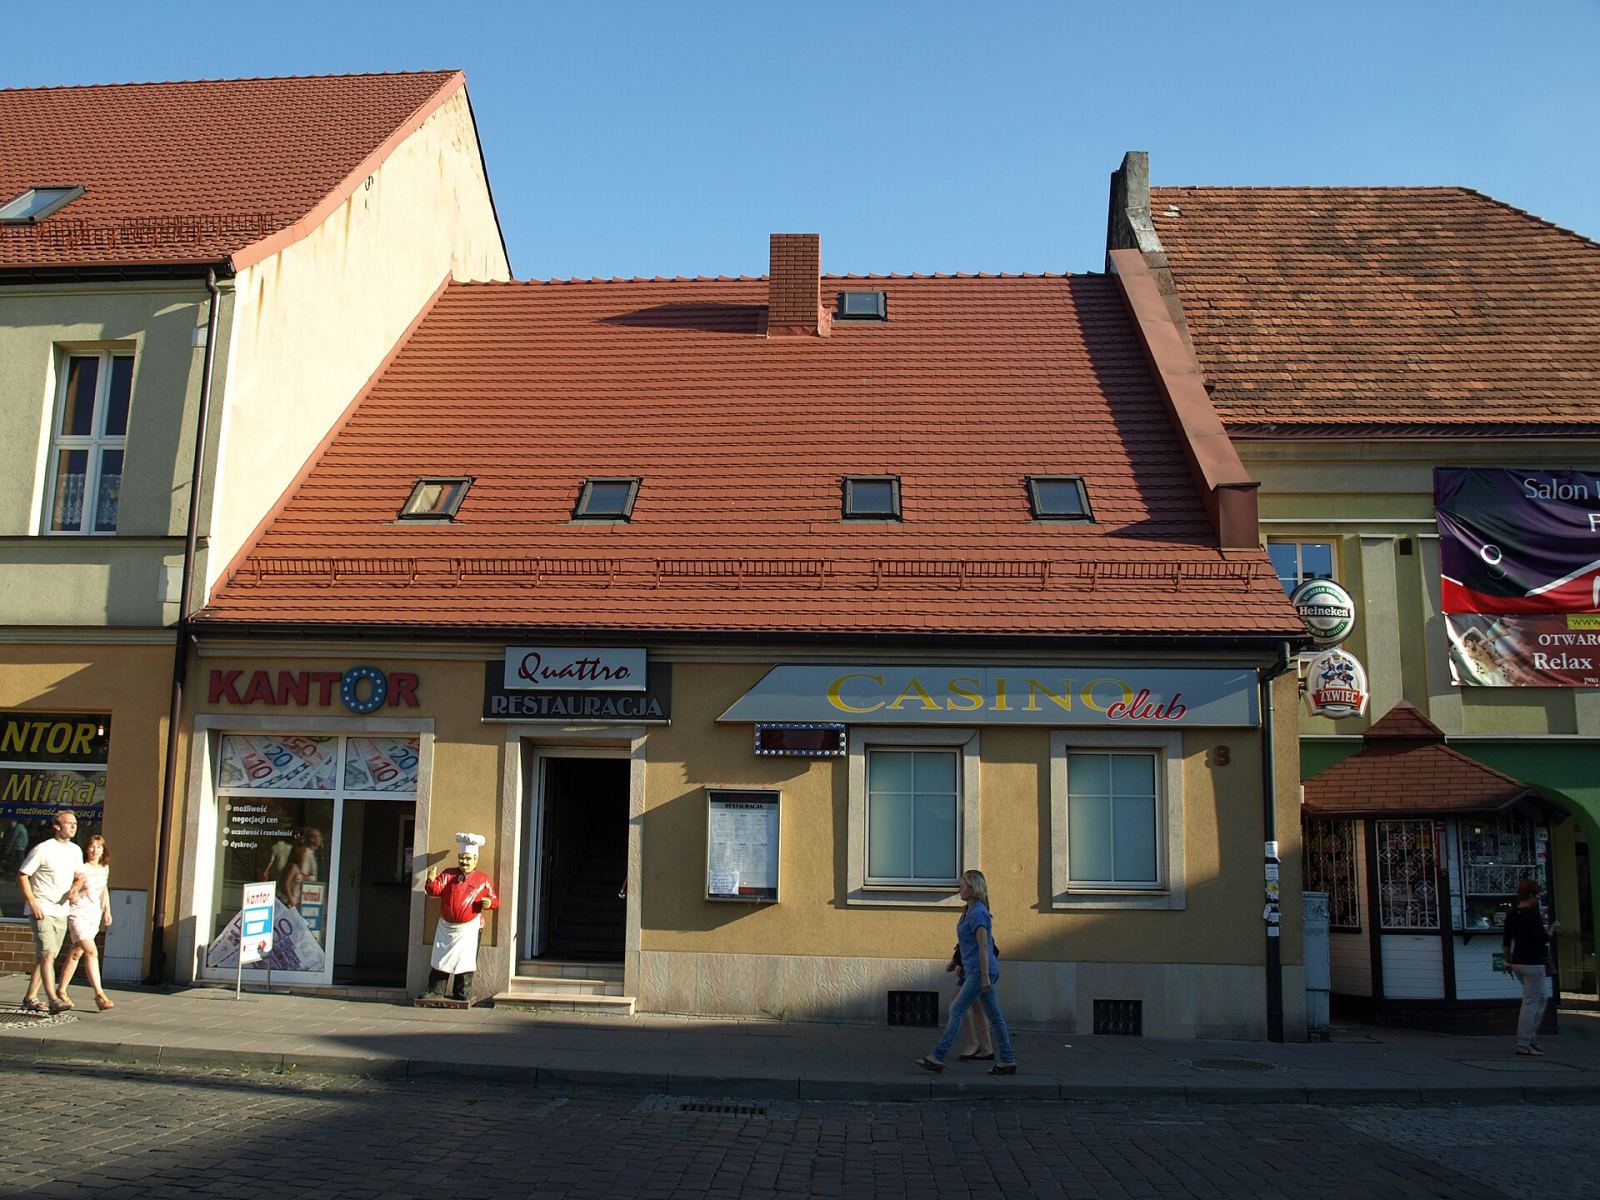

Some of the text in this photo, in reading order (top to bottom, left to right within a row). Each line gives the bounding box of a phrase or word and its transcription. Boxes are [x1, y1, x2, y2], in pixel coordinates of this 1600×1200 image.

[1523, 478, 1588, 500] Salon
[1299, 606, 1349, 618] Heineken
[518, 652, 630, 683] Quattro
[1532, 652, 1593, 670] Relax
[208, 665, 421, 715] KANTOR
[491, 695, 664, 716] RESTAURACJA
[826, 673, 1134, 713] CASINO
[1106, 688, 1187, 721] club
[0, 721, 97, 754] NTOR
